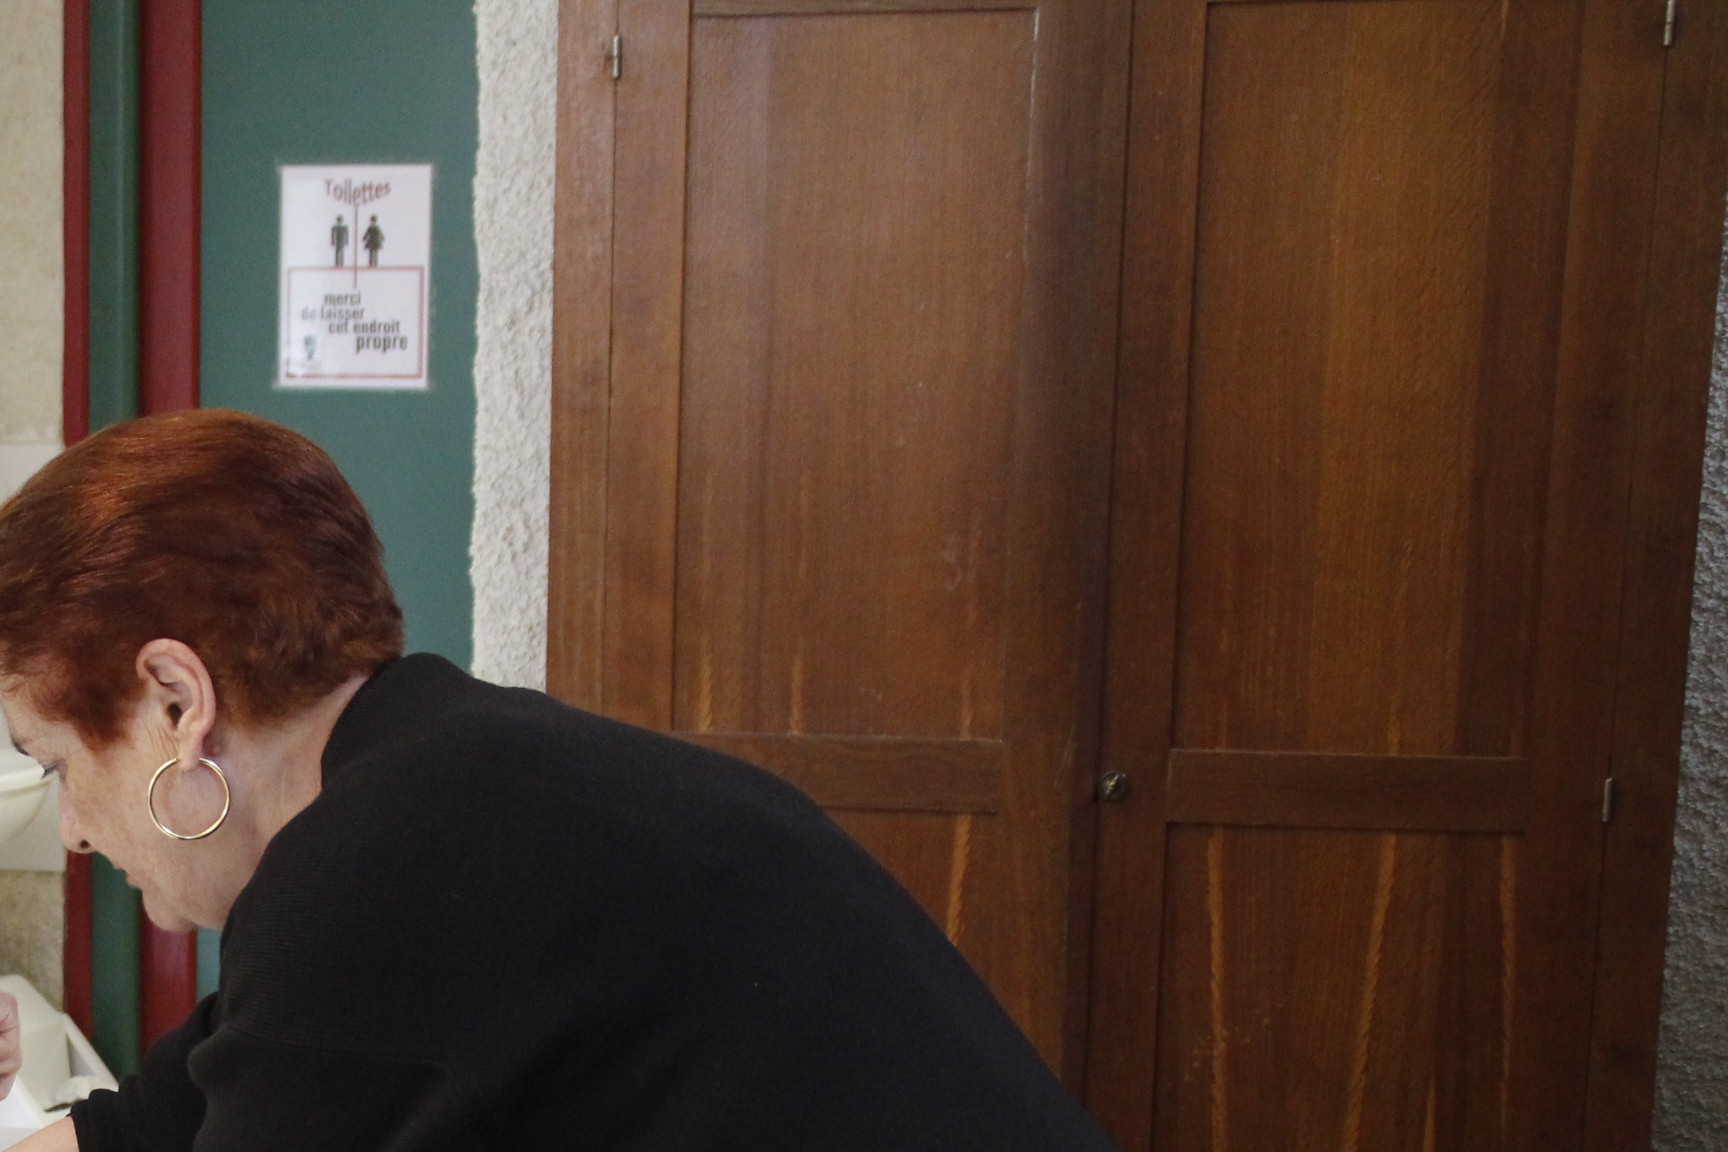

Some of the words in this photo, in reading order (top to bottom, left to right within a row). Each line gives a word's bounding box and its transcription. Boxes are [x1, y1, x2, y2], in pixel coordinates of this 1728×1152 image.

[324, 179, 391, 208] Toilettes
[324, 291, 361, 305] merci
[301, 305, 317, 320] de
[320, 306, 365, 320] laisser
[329, 319, 349, 334] cet
[353, 319, 400, 334] endroit
[356, 335, 408, 354] propre
